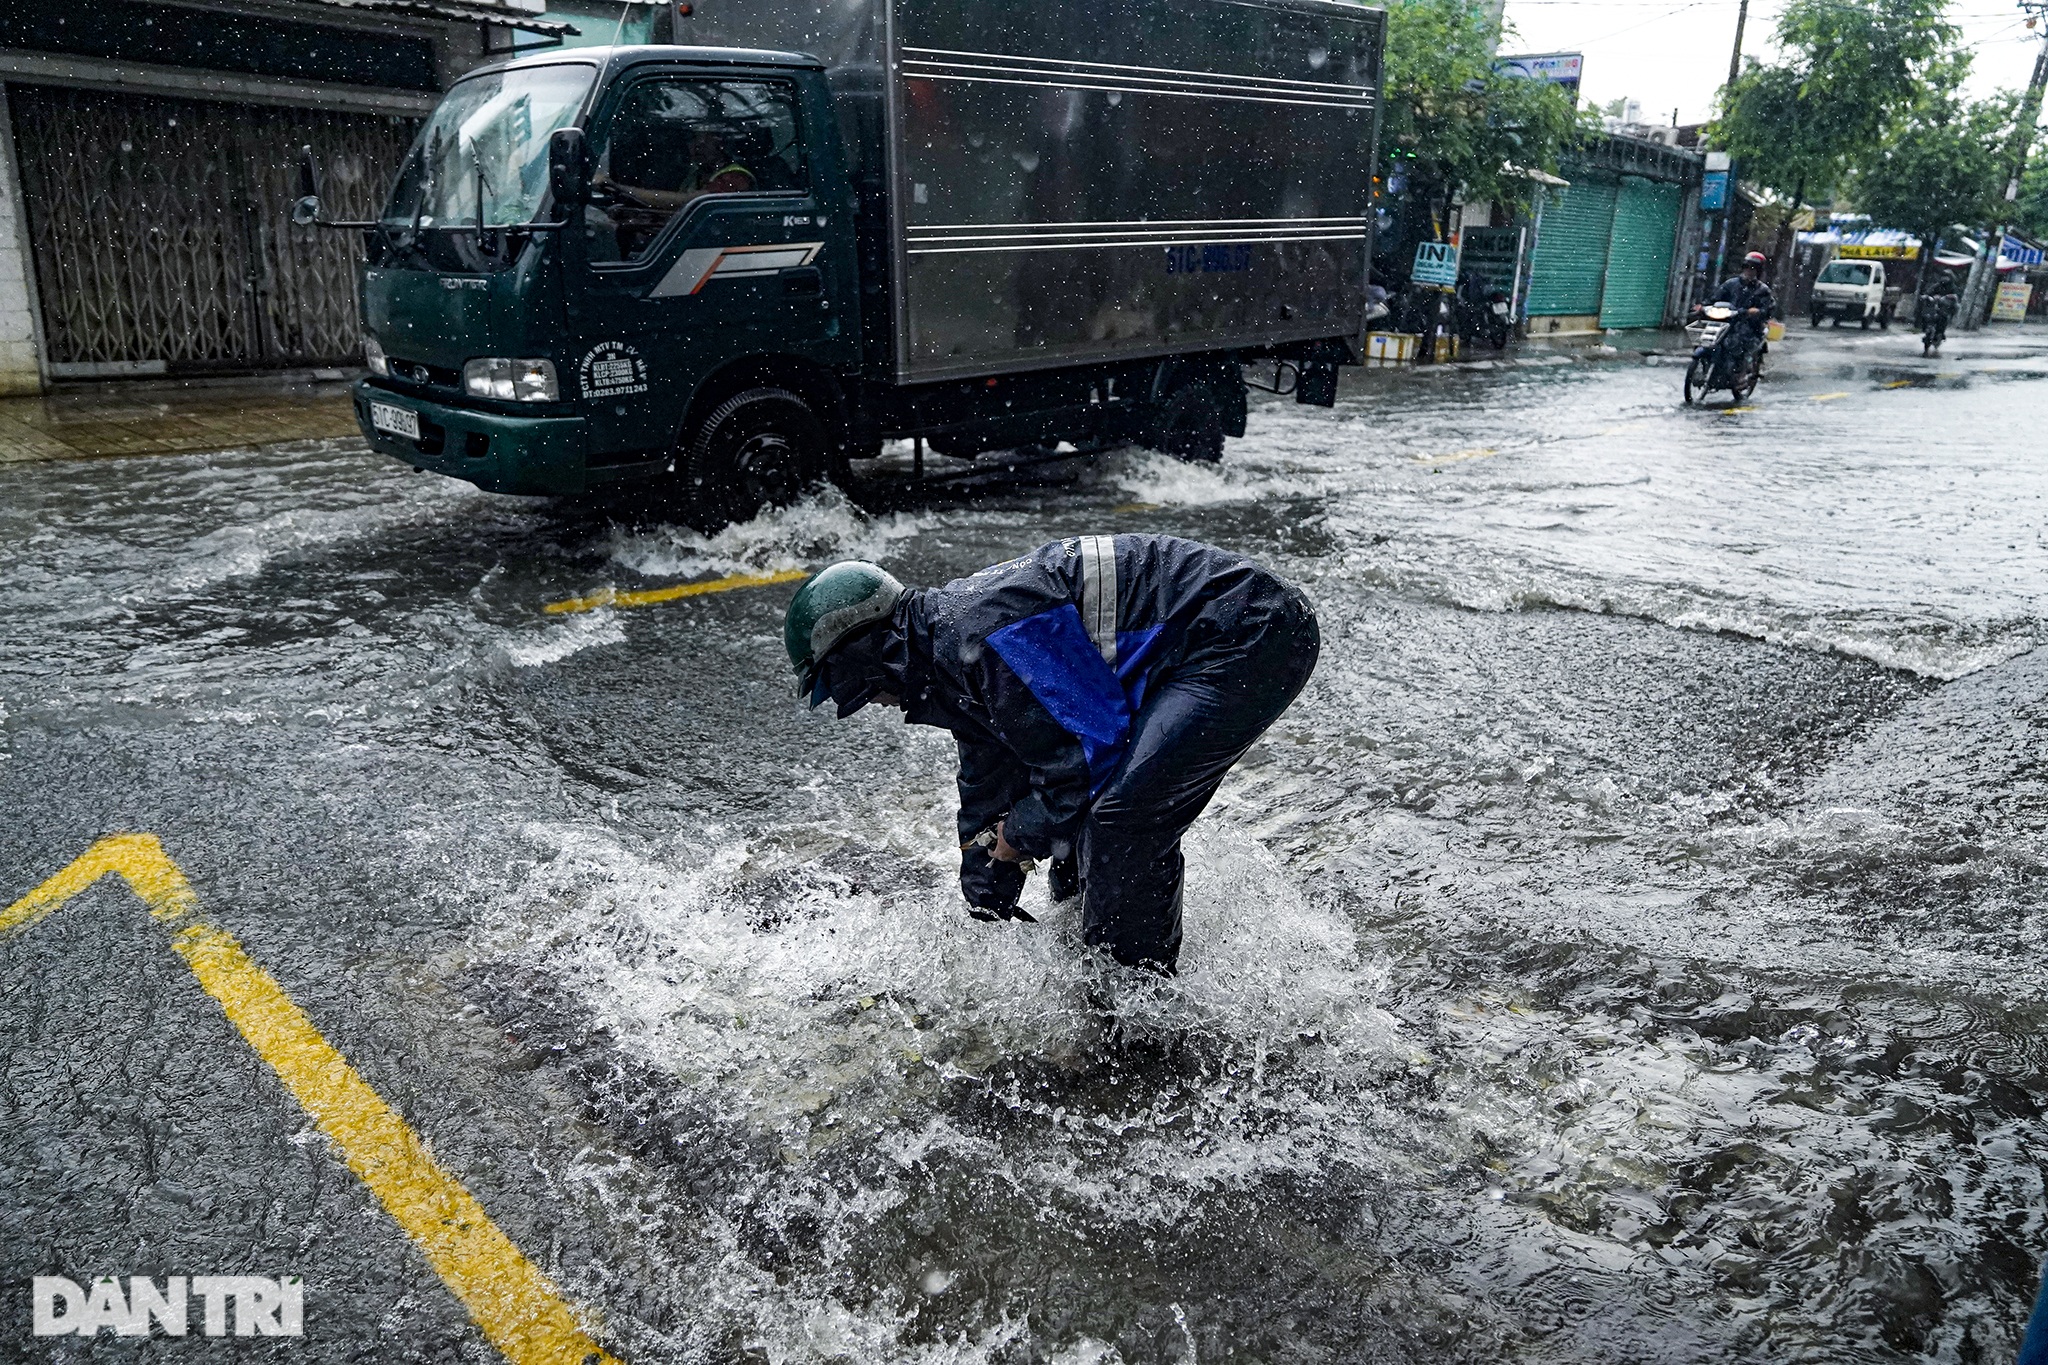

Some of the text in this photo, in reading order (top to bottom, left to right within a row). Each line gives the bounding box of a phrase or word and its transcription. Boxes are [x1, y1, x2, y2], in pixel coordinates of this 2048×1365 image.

[580, 351, 596, 372] TNHH
[593, 341, 610, 354] MTV
[611, 341, 624, 351] TM
